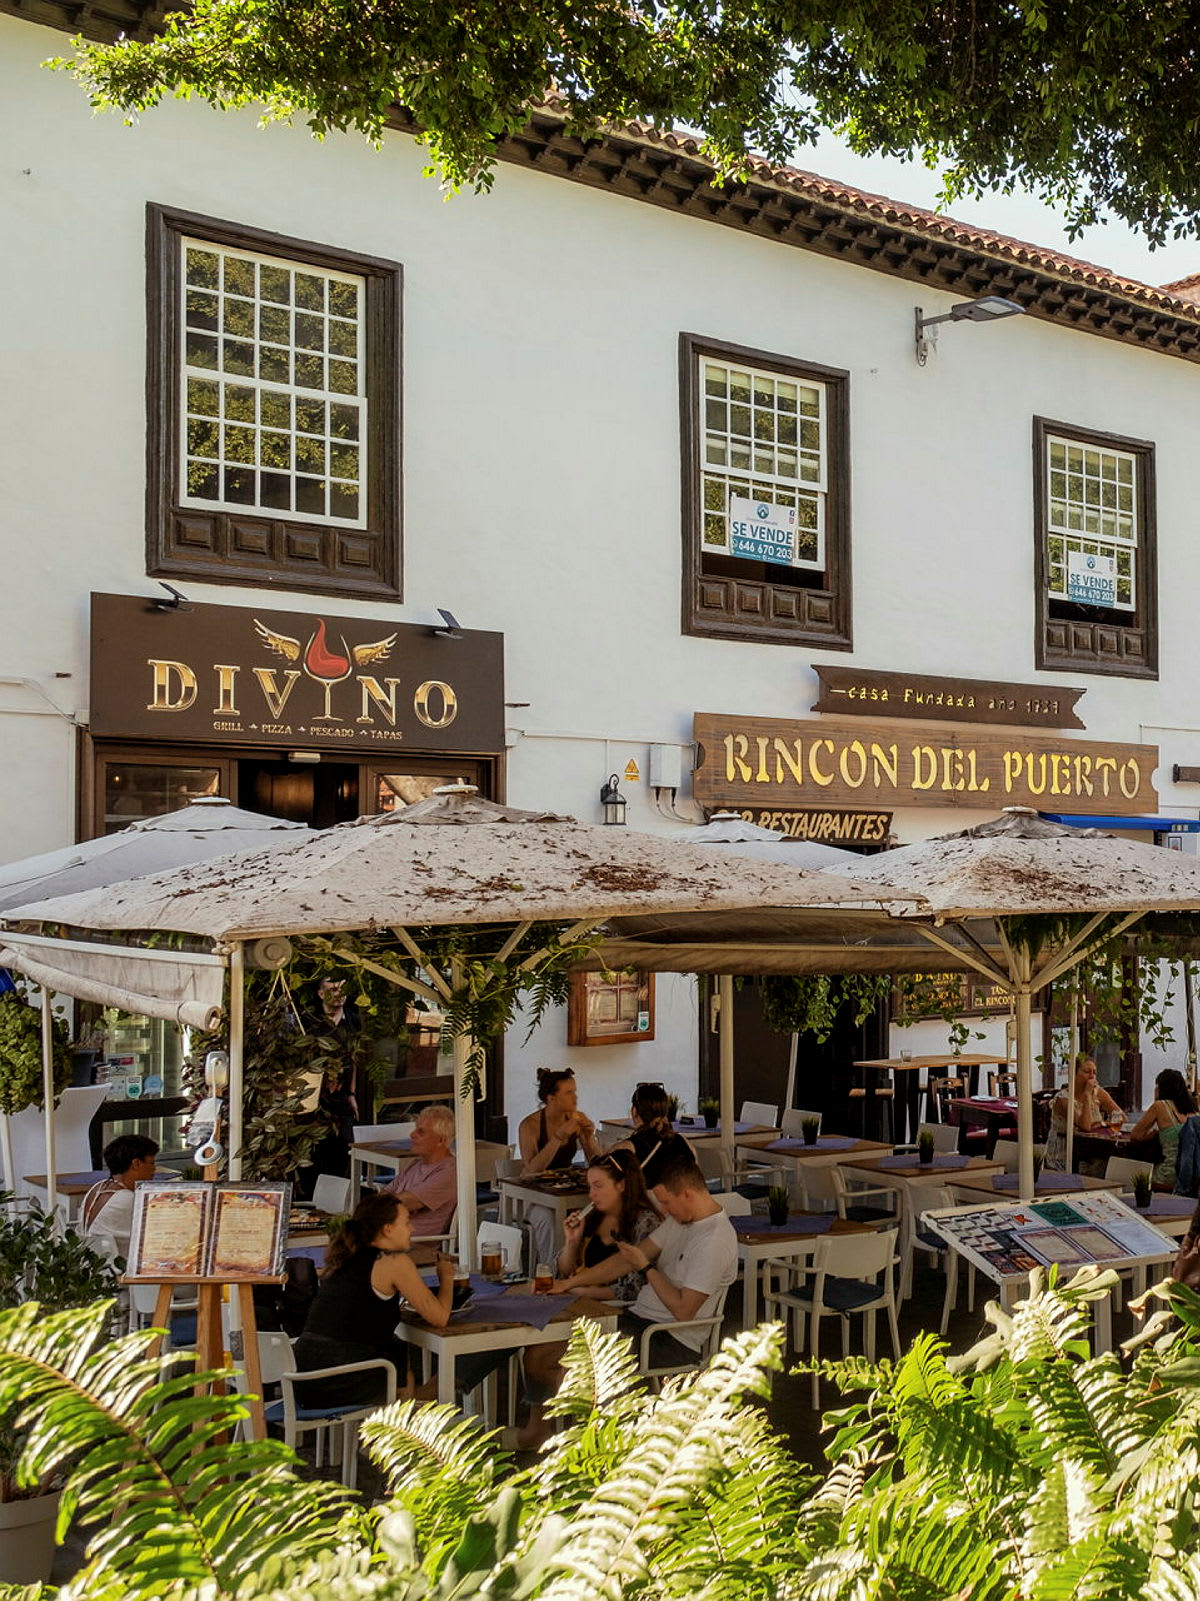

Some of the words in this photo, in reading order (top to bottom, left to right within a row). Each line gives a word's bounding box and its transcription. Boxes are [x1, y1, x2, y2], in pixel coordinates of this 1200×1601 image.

[732, 521, 747, 536] SE
[750, 524, 793, 545] VENDE
[738, 539, 754, 552] 646
[757, 542, 774, 556] 670
[776, 547, 793, 560] 203
[1070, 573, 1081, 585] SE
[1083, 575, 1113, 591] VENDE
[147, 658, 458, 729] DIVINO
[213, 720, 245, 733] GRILL
[261, 723, 293, 735] PIZZA
[310, 726, 355, 739] PESCADO
[369, 729, 403, 741] TAPAS
[723, 733, 900, 789] RINCON
[911, 745, 991, 792] DEL
[1002, 750, 1141, 799] PUERTO
